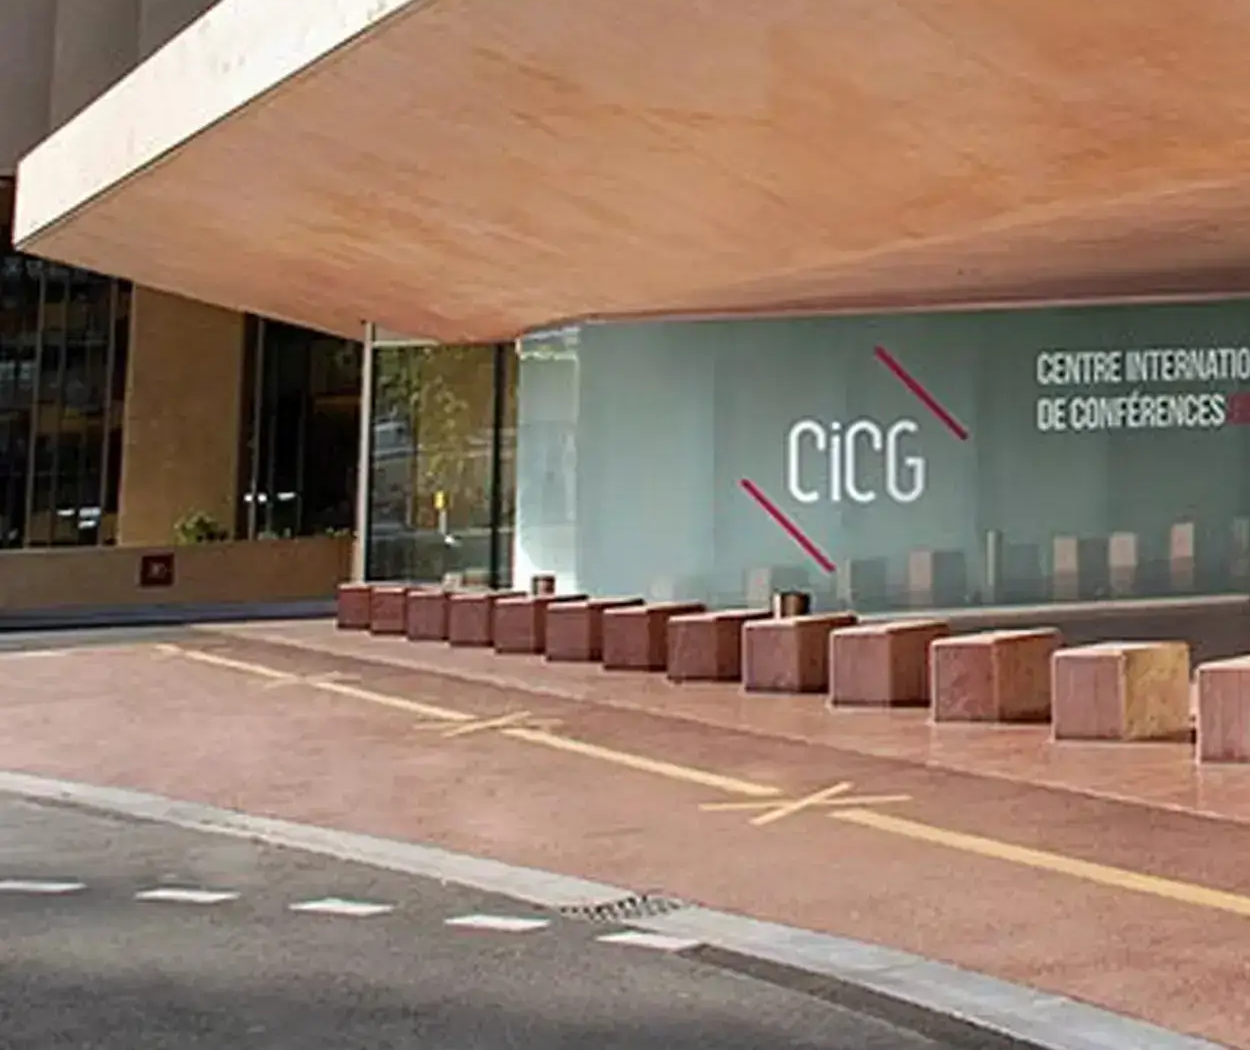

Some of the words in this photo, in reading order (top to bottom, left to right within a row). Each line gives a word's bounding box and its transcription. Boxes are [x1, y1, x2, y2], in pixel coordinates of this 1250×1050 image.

[1036, 352, 1121, 384] CENTRE
[1037, 396, 1066, 430] DE
[1070, 391, 1226, 428] CONFÉRENCES
